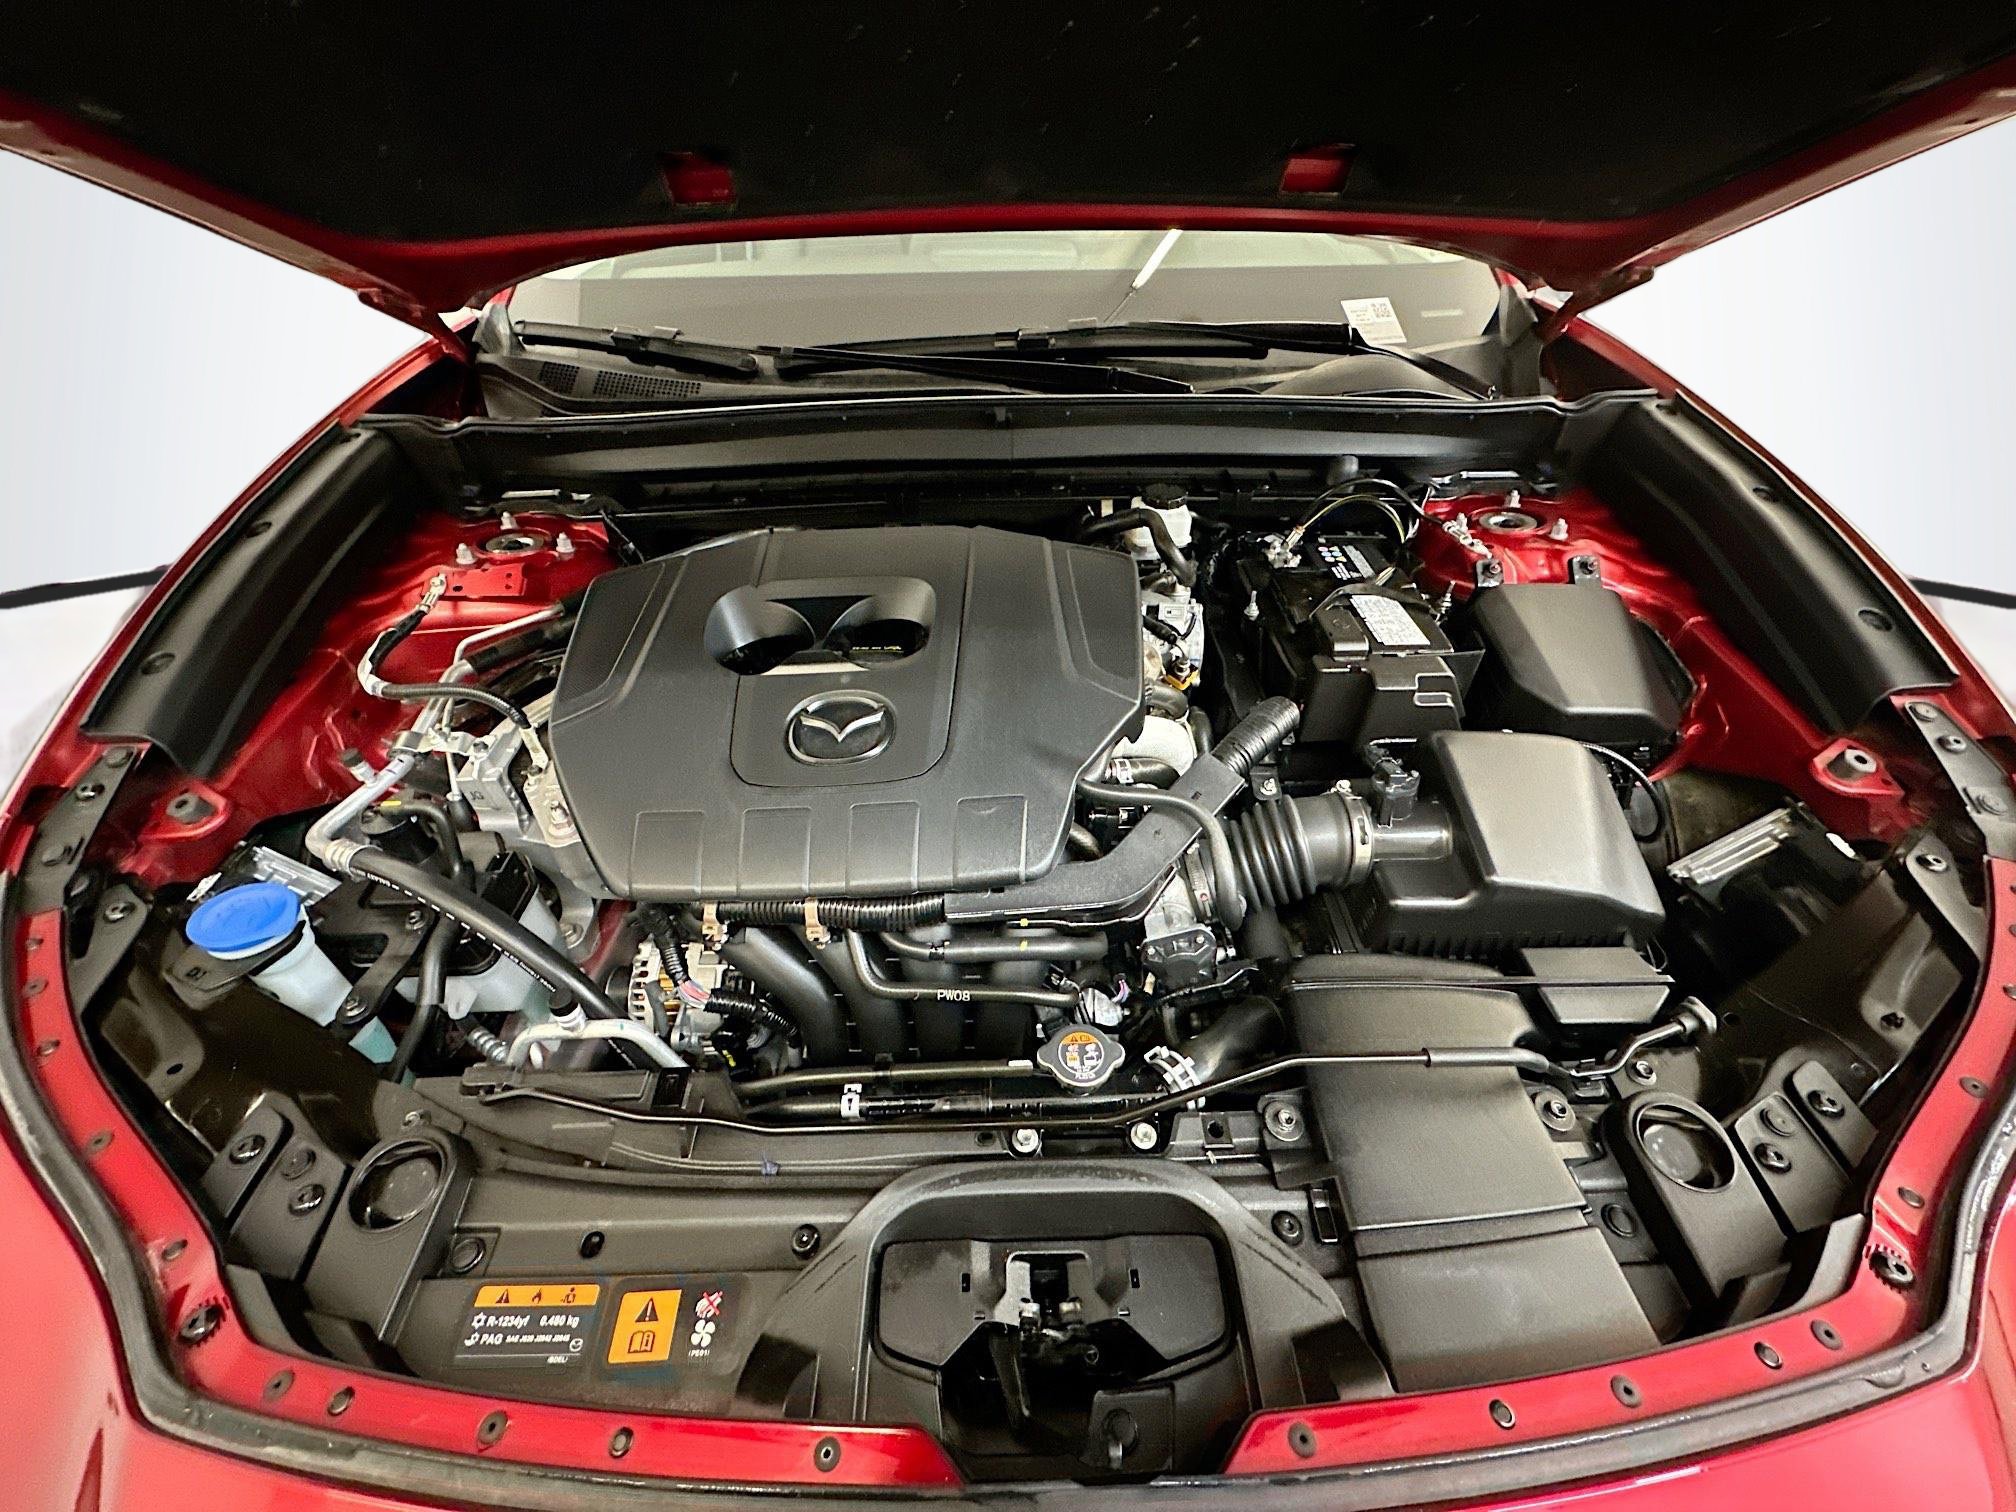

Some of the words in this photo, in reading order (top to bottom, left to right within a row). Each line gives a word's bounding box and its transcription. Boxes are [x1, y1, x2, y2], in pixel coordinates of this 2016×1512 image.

[937, 989, 971, 1002] PW08
[566, 1314, 580, 1329] kg
[479, 1333, 504, 1345] PAG
